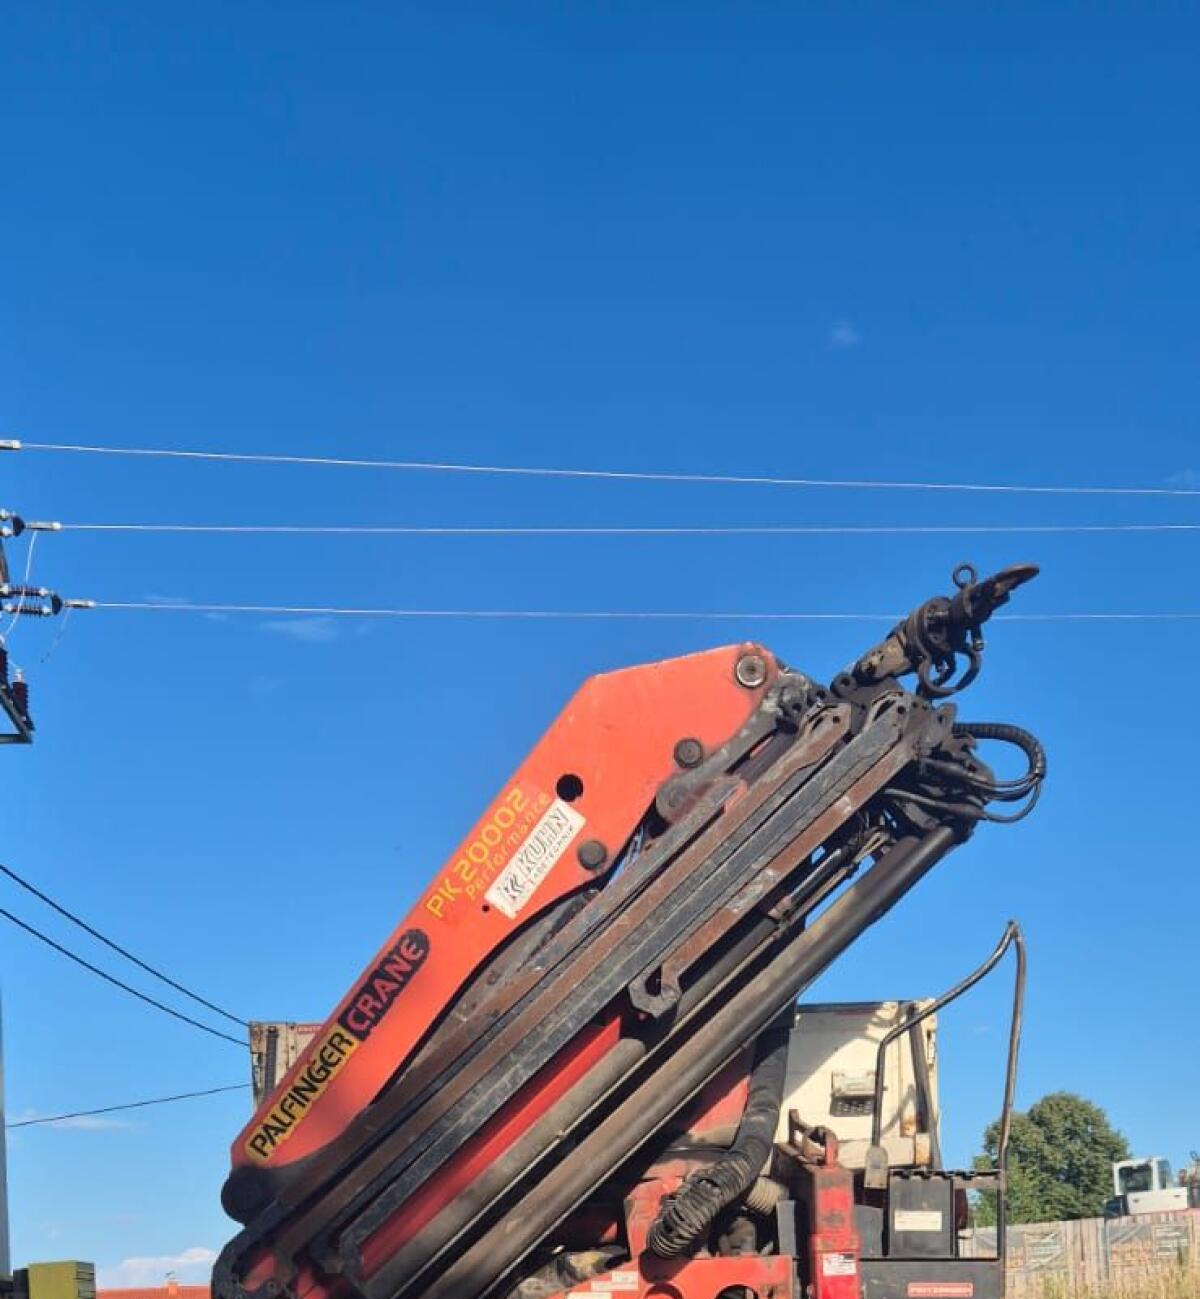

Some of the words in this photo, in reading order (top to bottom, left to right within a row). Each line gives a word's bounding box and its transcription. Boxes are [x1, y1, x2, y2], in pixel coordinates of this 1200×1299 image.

[425, 878, 463, 918] PK
[453, 788, 528, 881] 20002
[465, 792, 549, 901] Performance
[517, 806, 568, 873] KUHN
[250, 1031, 355, 1158] PALFINGER
[347, 937, 424, 1033] CRANE
